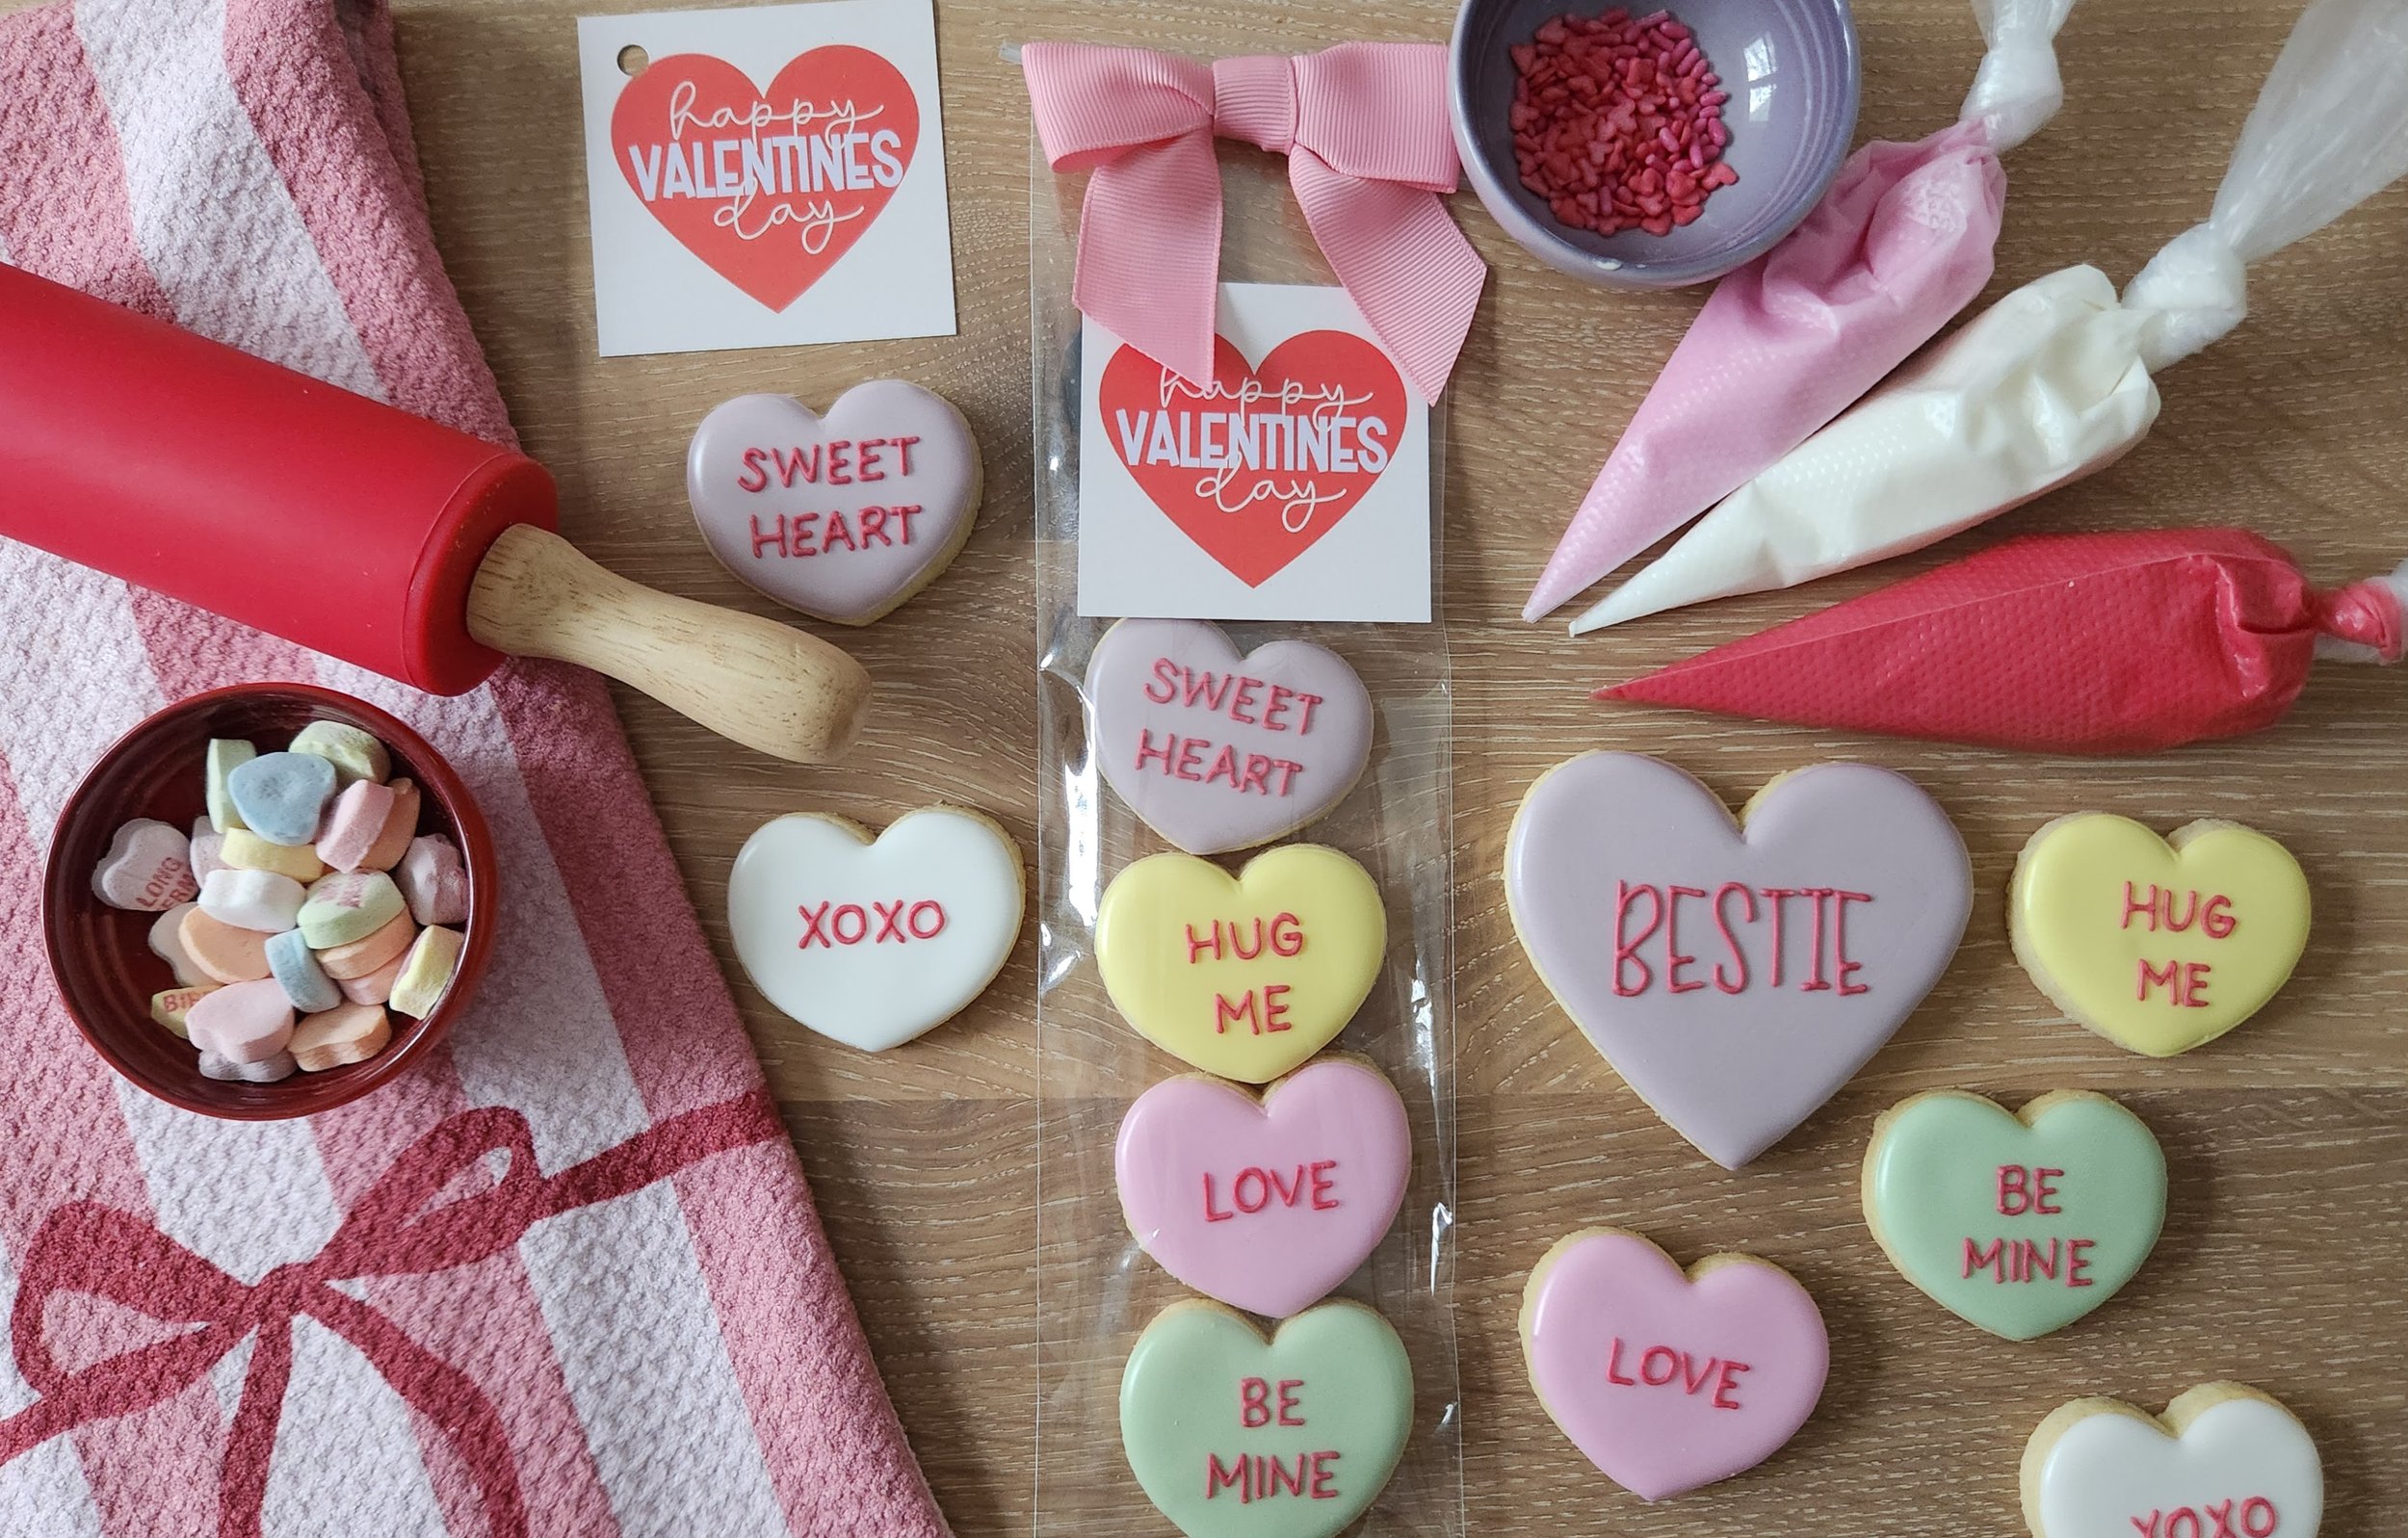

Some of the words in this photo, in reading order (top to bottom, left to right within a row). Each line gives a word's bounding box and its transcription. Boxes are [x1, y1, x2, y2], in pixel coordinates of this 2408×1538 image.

[669, 80, 885, 151] happy
[628, 129, 904, 201] VALENTINES
[714, 177, 865, 255] day
[737, 436, 920, 492] SWEET
[1115, 408, 1389, 475] VALENTINES
[1195, 450, 1348, 534] day
[751, 505, 922, 559] HEART
[1143, 657, 1323, 736] SWEET
[1134, 728, 1304, 797] HEART
[136, 856, 183, 908] LONG
[2122, 880, 2238, 939] HUG
[798, 899, 946, 950] XOXO
[1185, 912, 1304, 964] HUG
[1611, 879, 1872, 998] BESTIE
[1215, 985, 1293, 1035] ME
[2137, 960, 2212, 1008] ME
[1203, 1159, 1341, 1223] LOVE
[1996, 1164, 2063, 1216] BE
[1962, 1238, 2096, 1288] MINE
[1607, 1337, 1751, 1410] LOVE
[1241, 1378, 1304, 1429] BE
[1206, 1449, 1341, 1503] MINE
